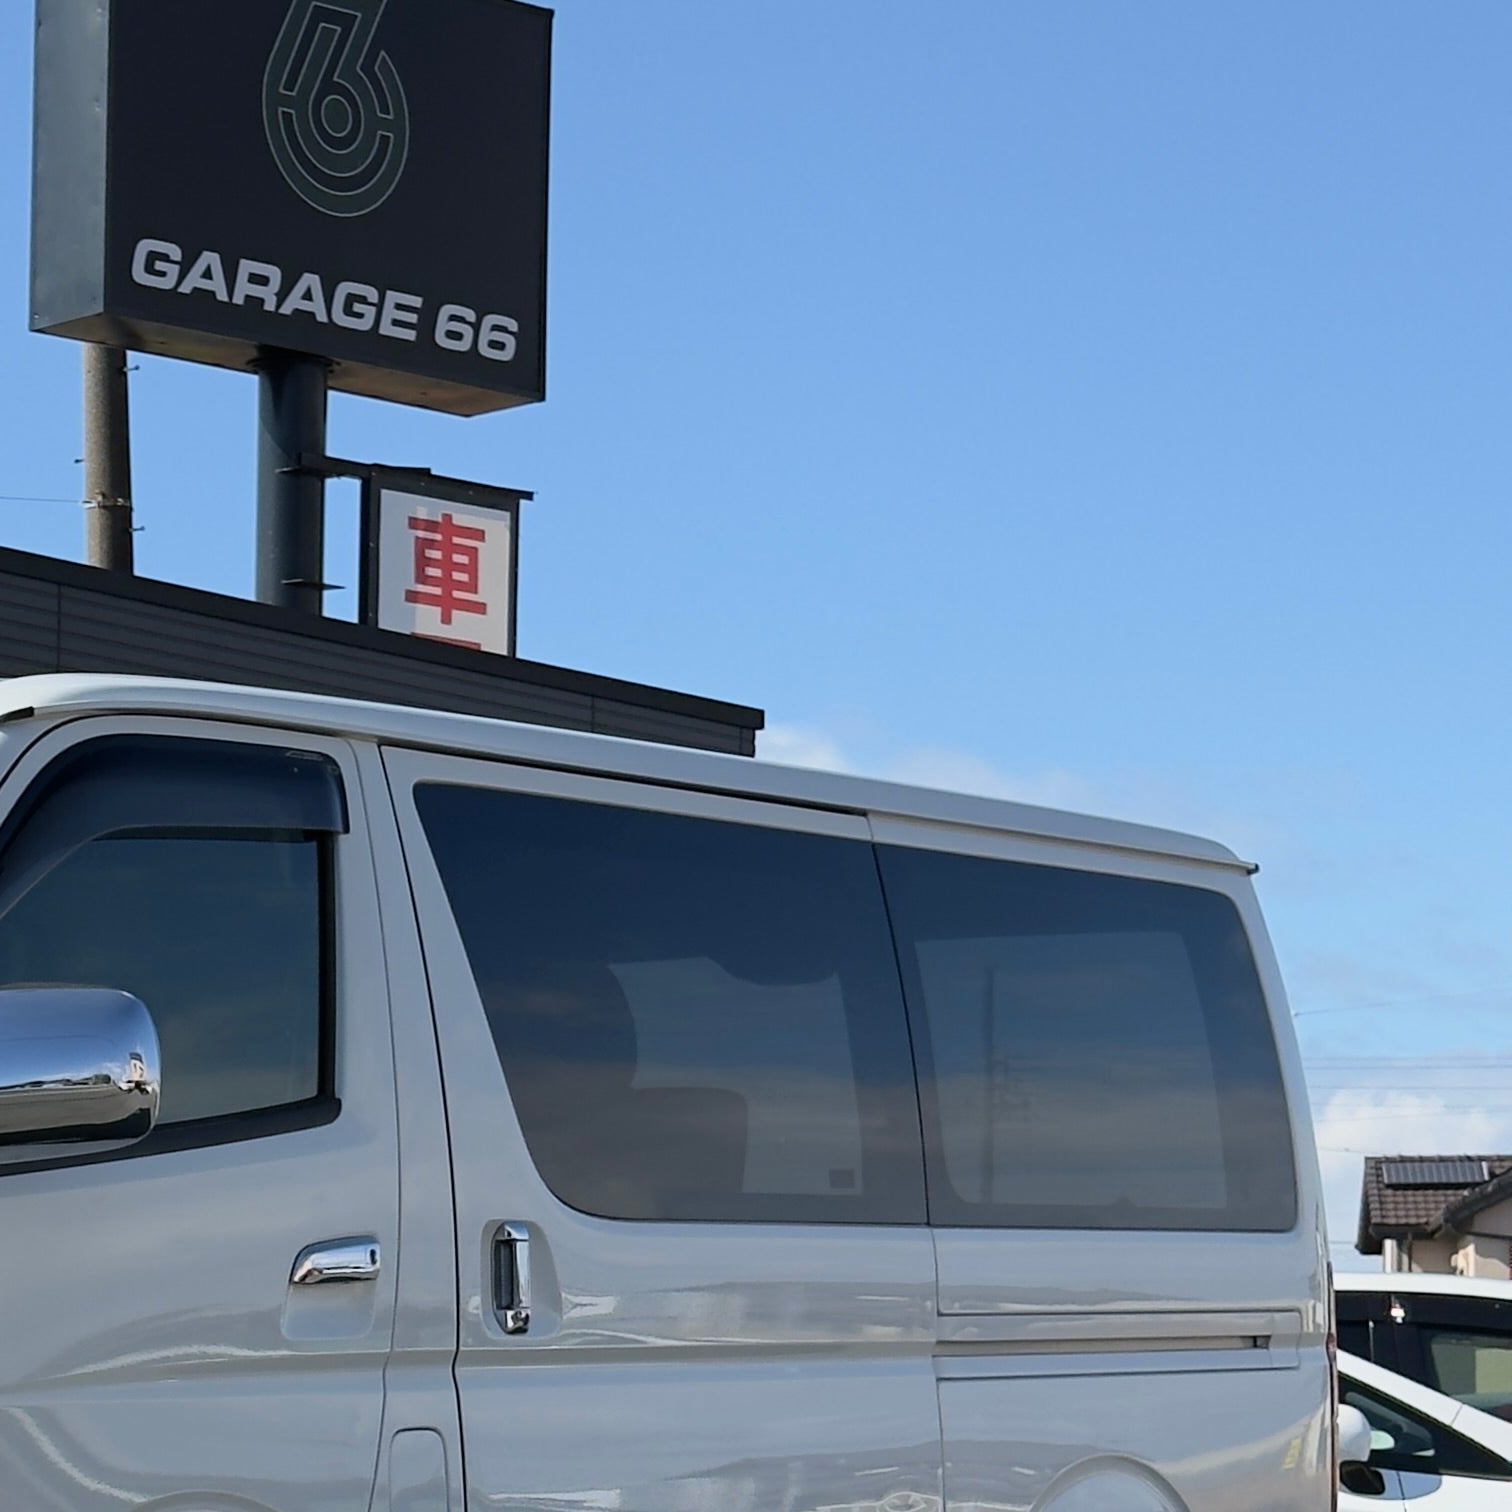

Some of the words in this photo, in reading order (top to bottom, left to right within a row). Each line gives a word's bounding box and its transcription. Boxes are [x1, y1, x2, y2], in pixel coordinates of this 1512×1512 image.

[131, 238, 424, 342] GARAGE
[433, 303, 520, 362] 66
[404, 512, 487, 651] 車
